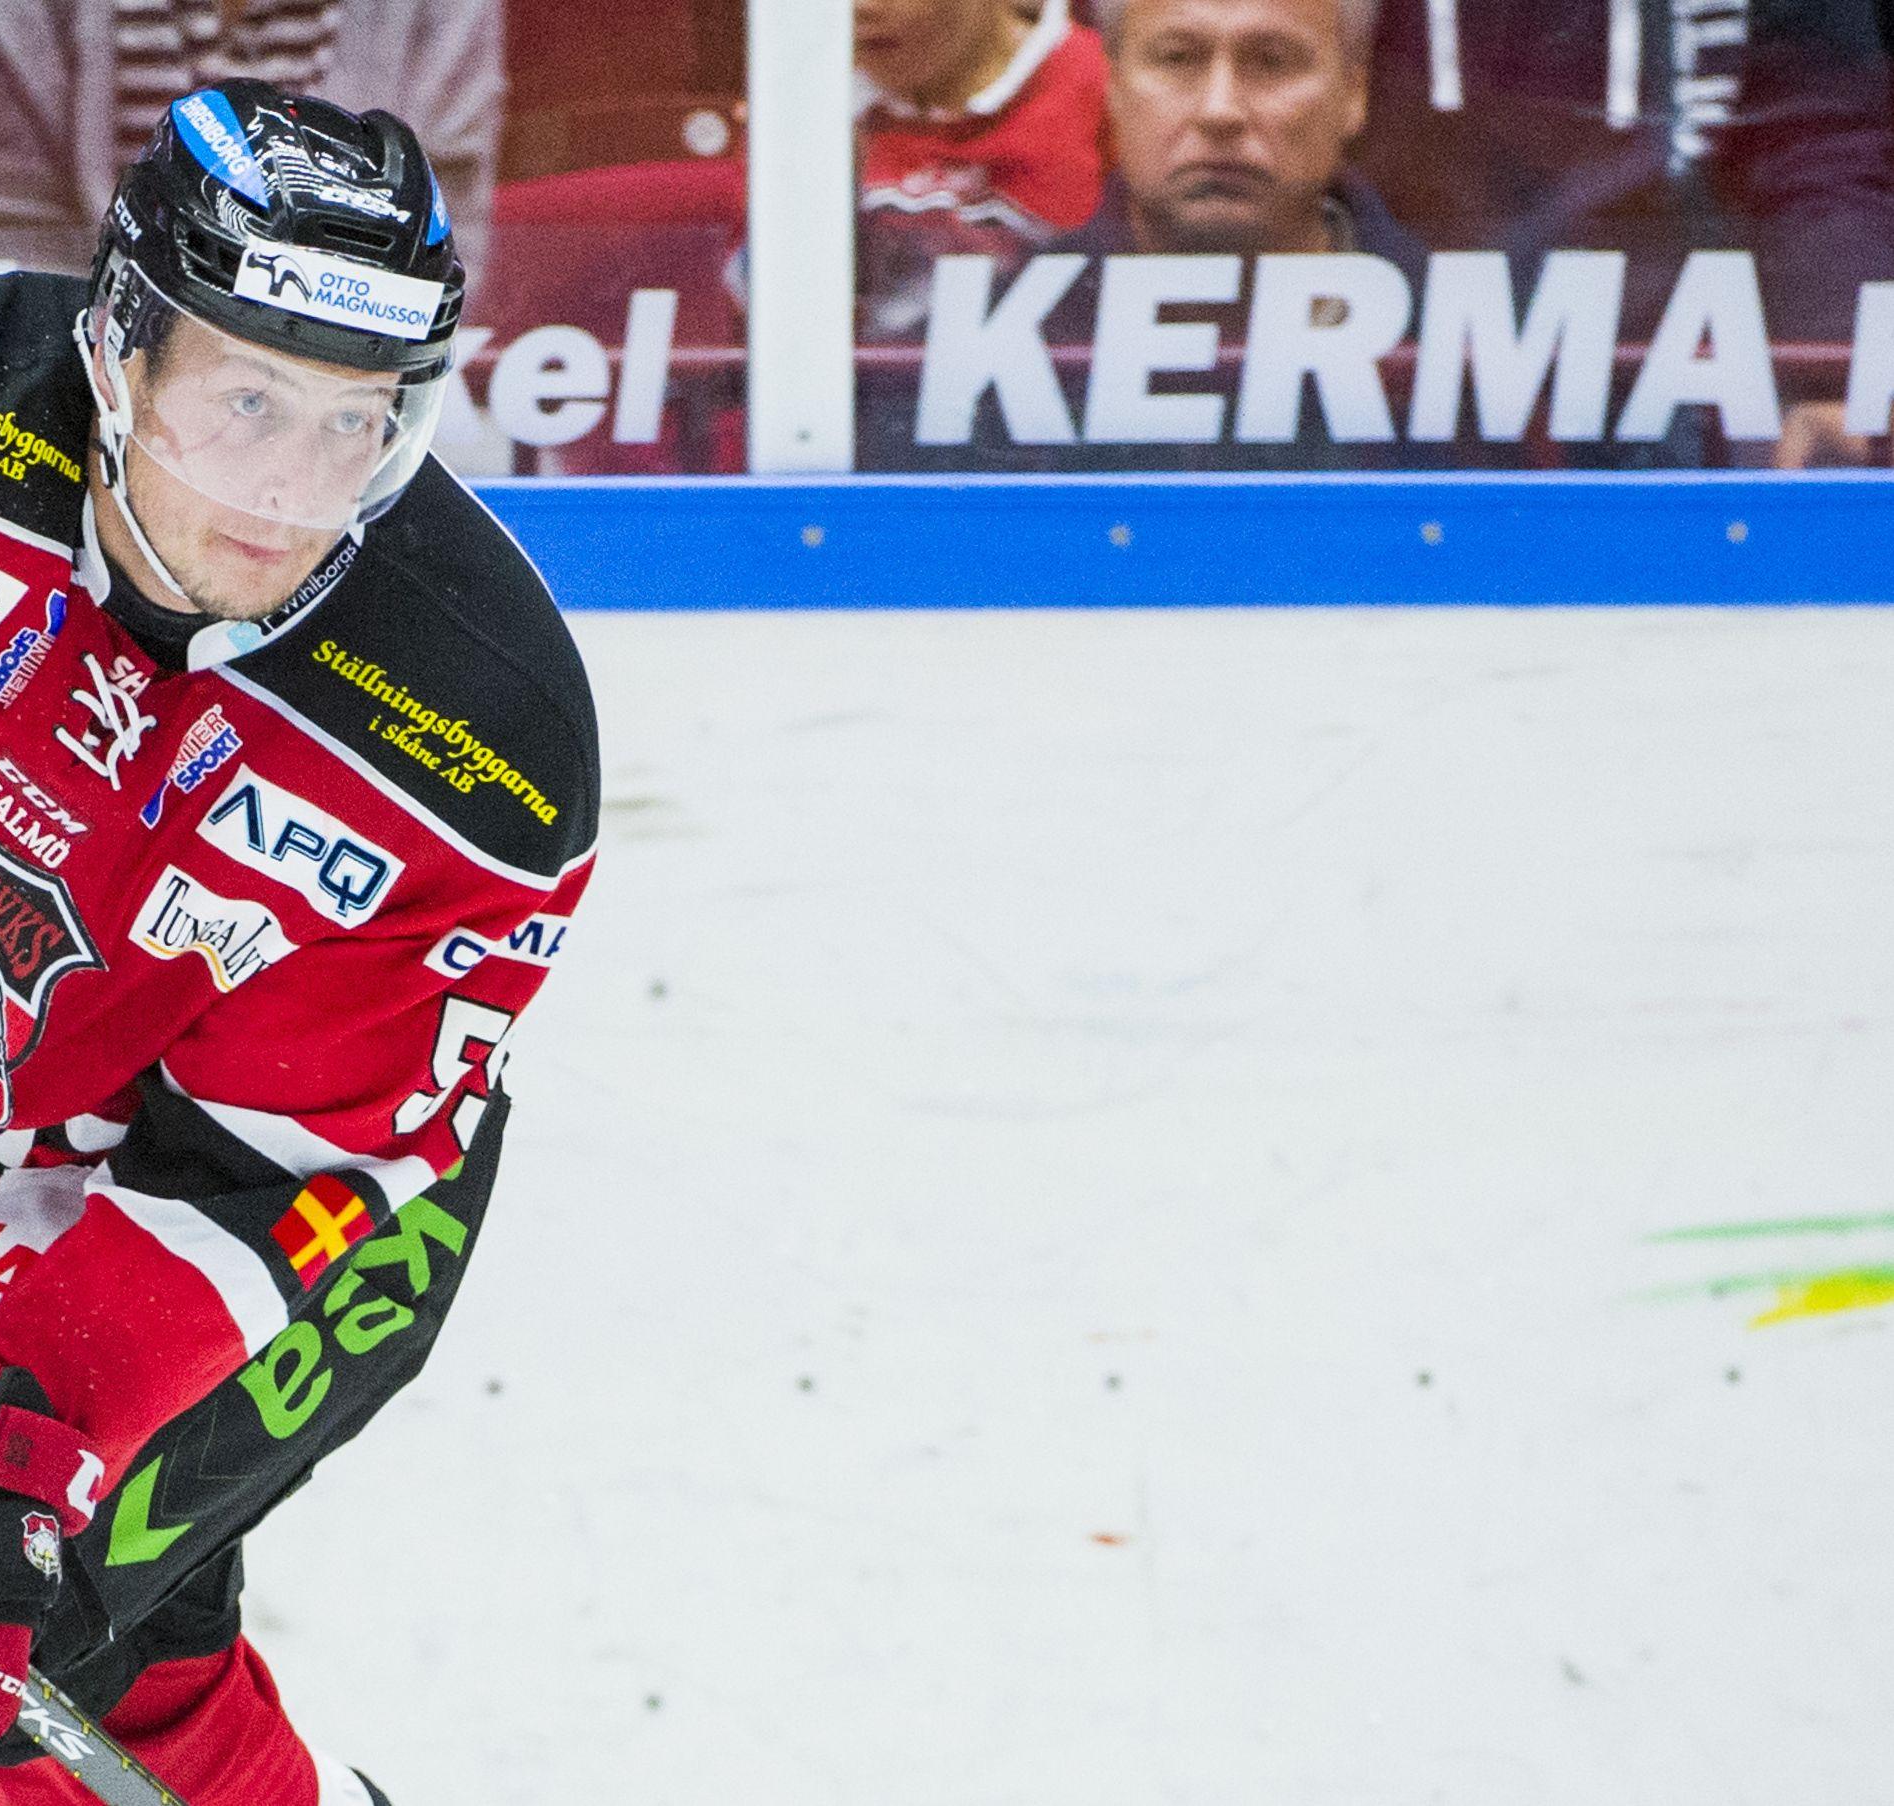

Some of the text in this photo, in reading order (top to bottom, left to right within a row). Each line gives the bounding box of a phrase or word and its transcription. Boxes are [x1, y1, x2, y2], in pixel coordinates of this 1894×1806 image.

[114, 195, 143, 241] CCM
[313, 288, 431, 327] MAGNUSSON
[320, 271, 370, 296] OTTO
[913, 249, 1782, 446] KERMA
[279, 542, 358, 616] Wihlborgs
[175, 726, 242, 793] SPORT
[312, 640, 559, 826] Ställningsbyggarna
[368, 715, 476, 794] i Skåne AB
[208, 783, 389, 918] APQ
[147, 874, 238, 949] TUNGA
